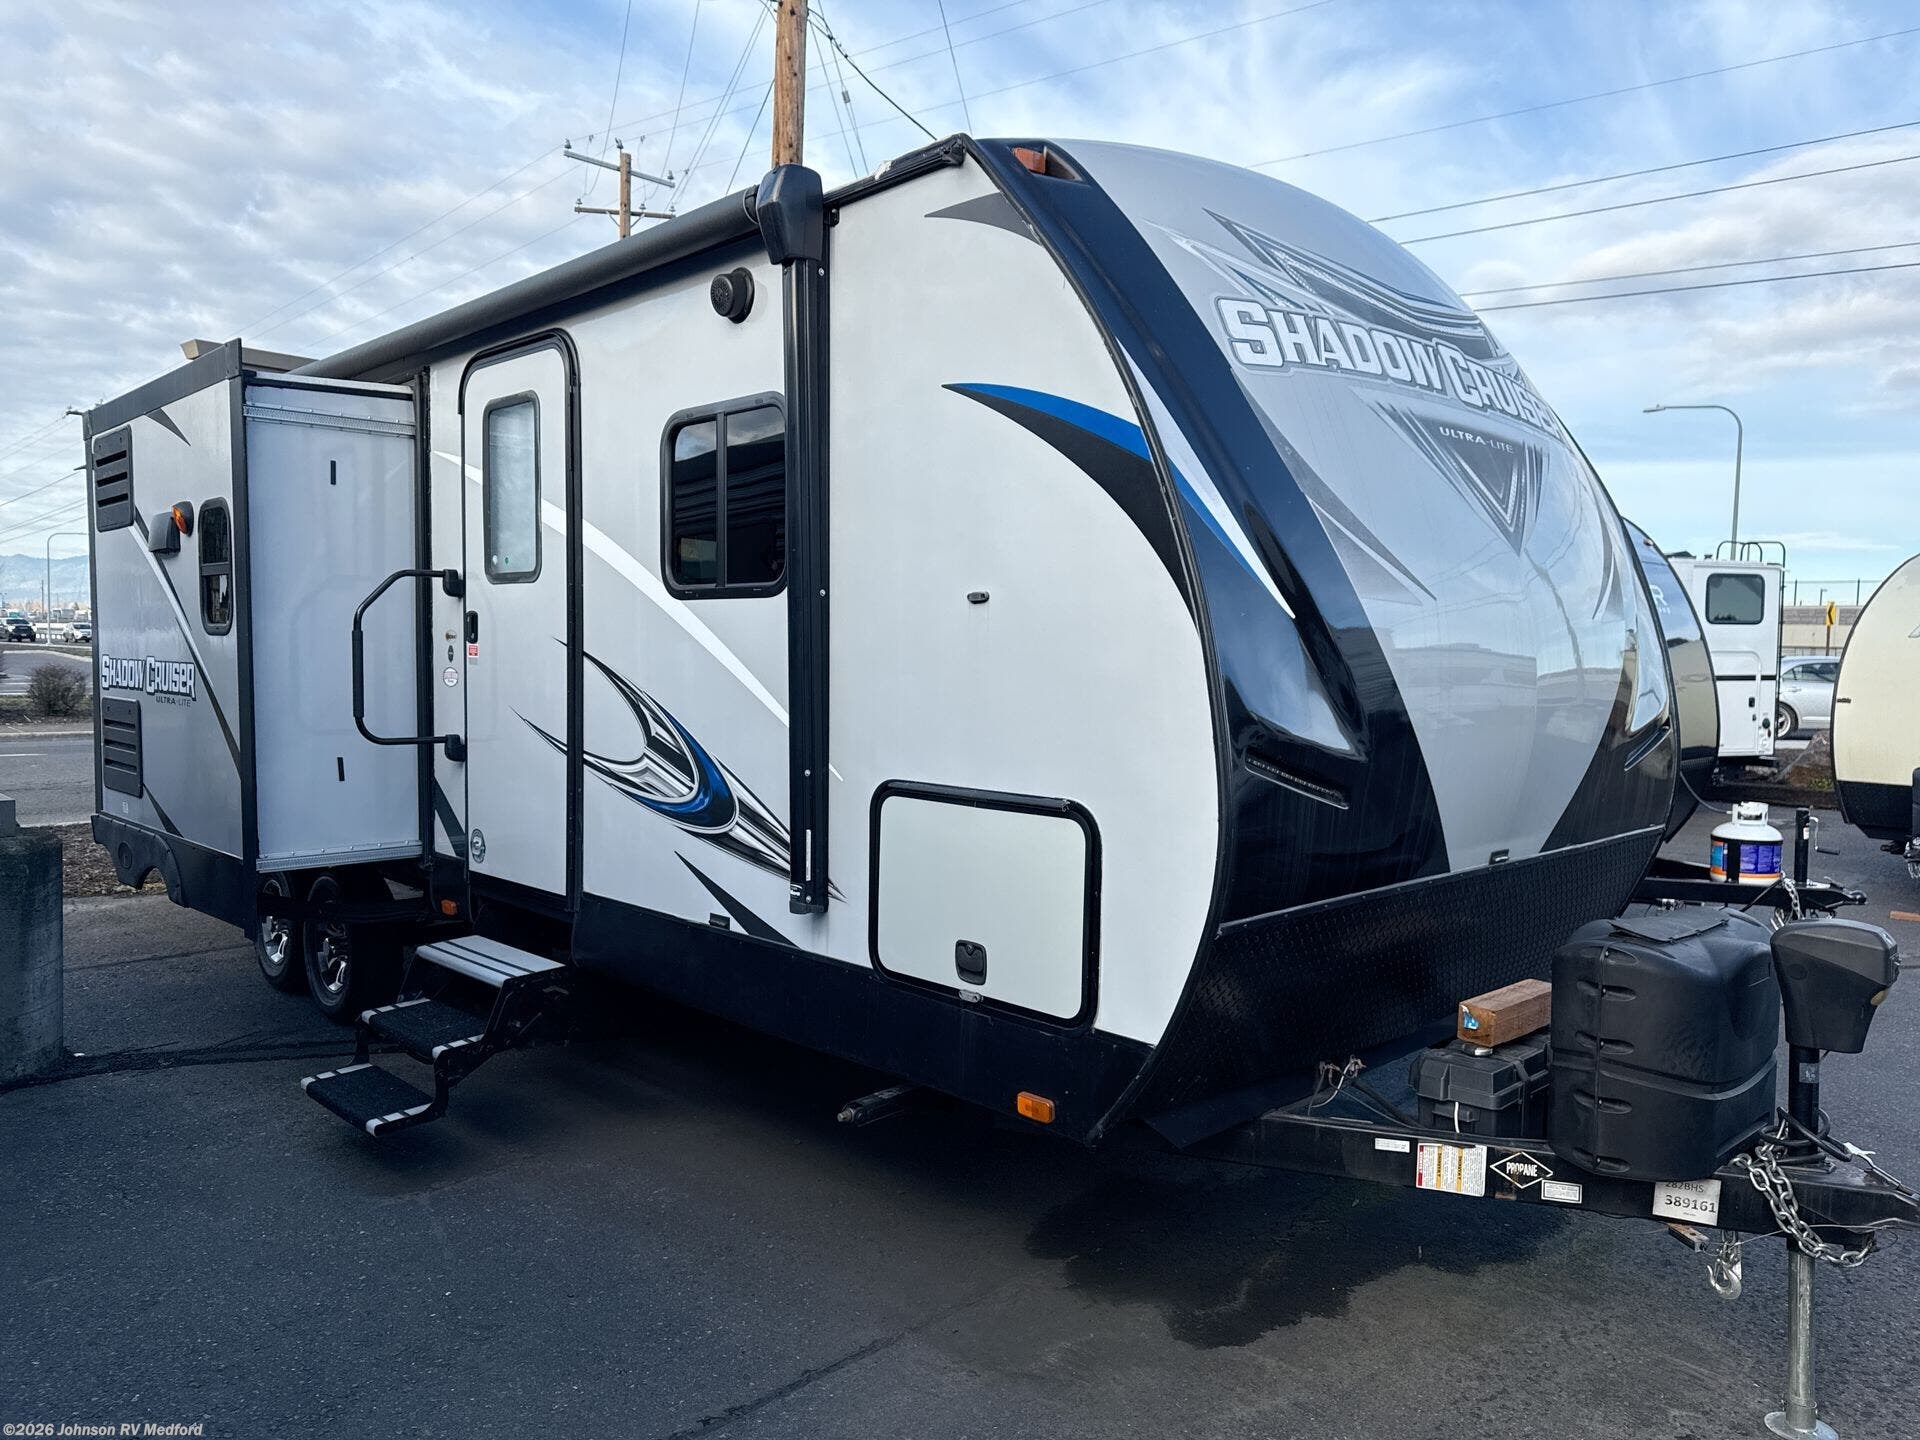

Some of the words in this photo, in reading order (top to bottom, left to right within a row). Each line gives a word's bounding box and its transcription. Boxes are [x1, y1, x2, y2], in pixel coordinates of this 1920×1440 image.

[1439, 426, 1514, 454] ULTRA-LITE
[1506, 1162, 1538, 1177] PROPANE
[1665, 1194, 1717, 1214] 389161
